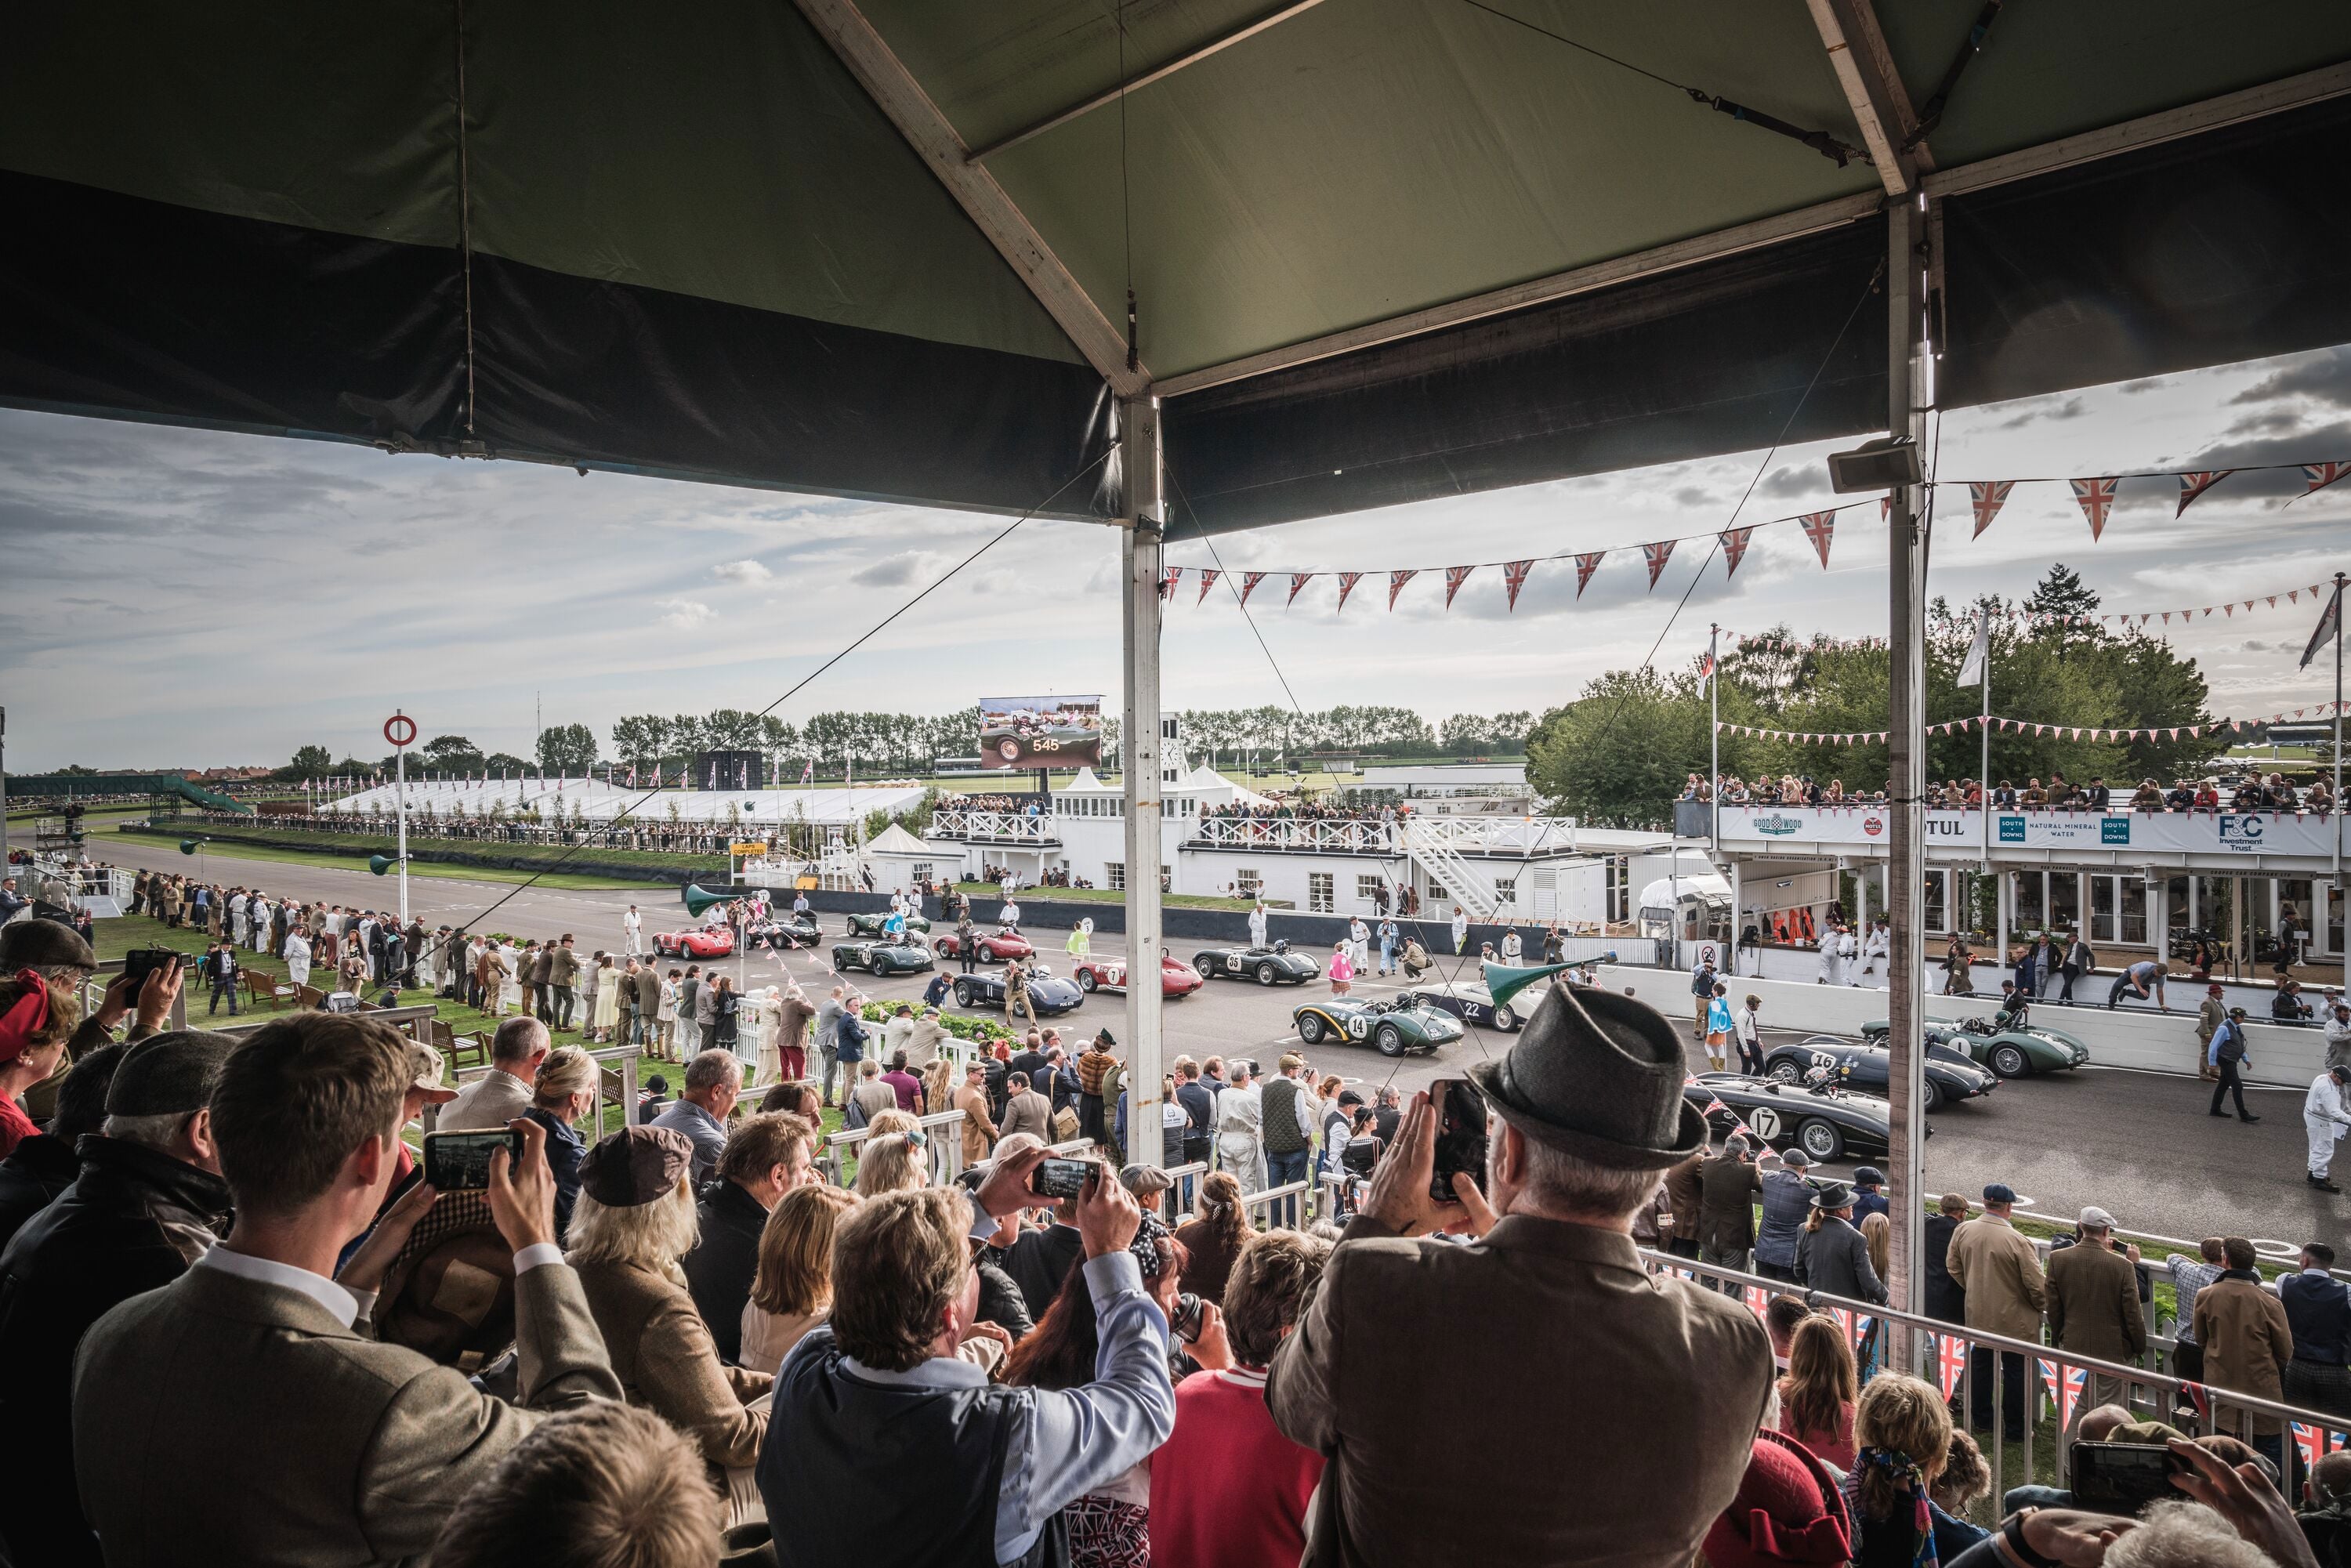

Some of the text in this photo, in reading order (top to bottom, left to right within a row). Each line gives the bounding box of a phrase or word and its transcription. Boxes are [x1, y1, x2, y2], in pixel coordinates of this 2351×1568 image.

[1033, 740, 1060, 751] 545
[2219, 815, 2263, 838] F&C
[864, 951, 870, 962] 74
[1229, 957, 1238, 968] 35
[1111, 971, 1116, 981] 7
[987, 983, 994, 998] 11
[1465, 1002, 1480, 1017] 22
[1353, 1019, 1364, 1034] 14
[1813, 1054, 1834, 1069] 16
[1756, 1113, 1776, 1136] 17
